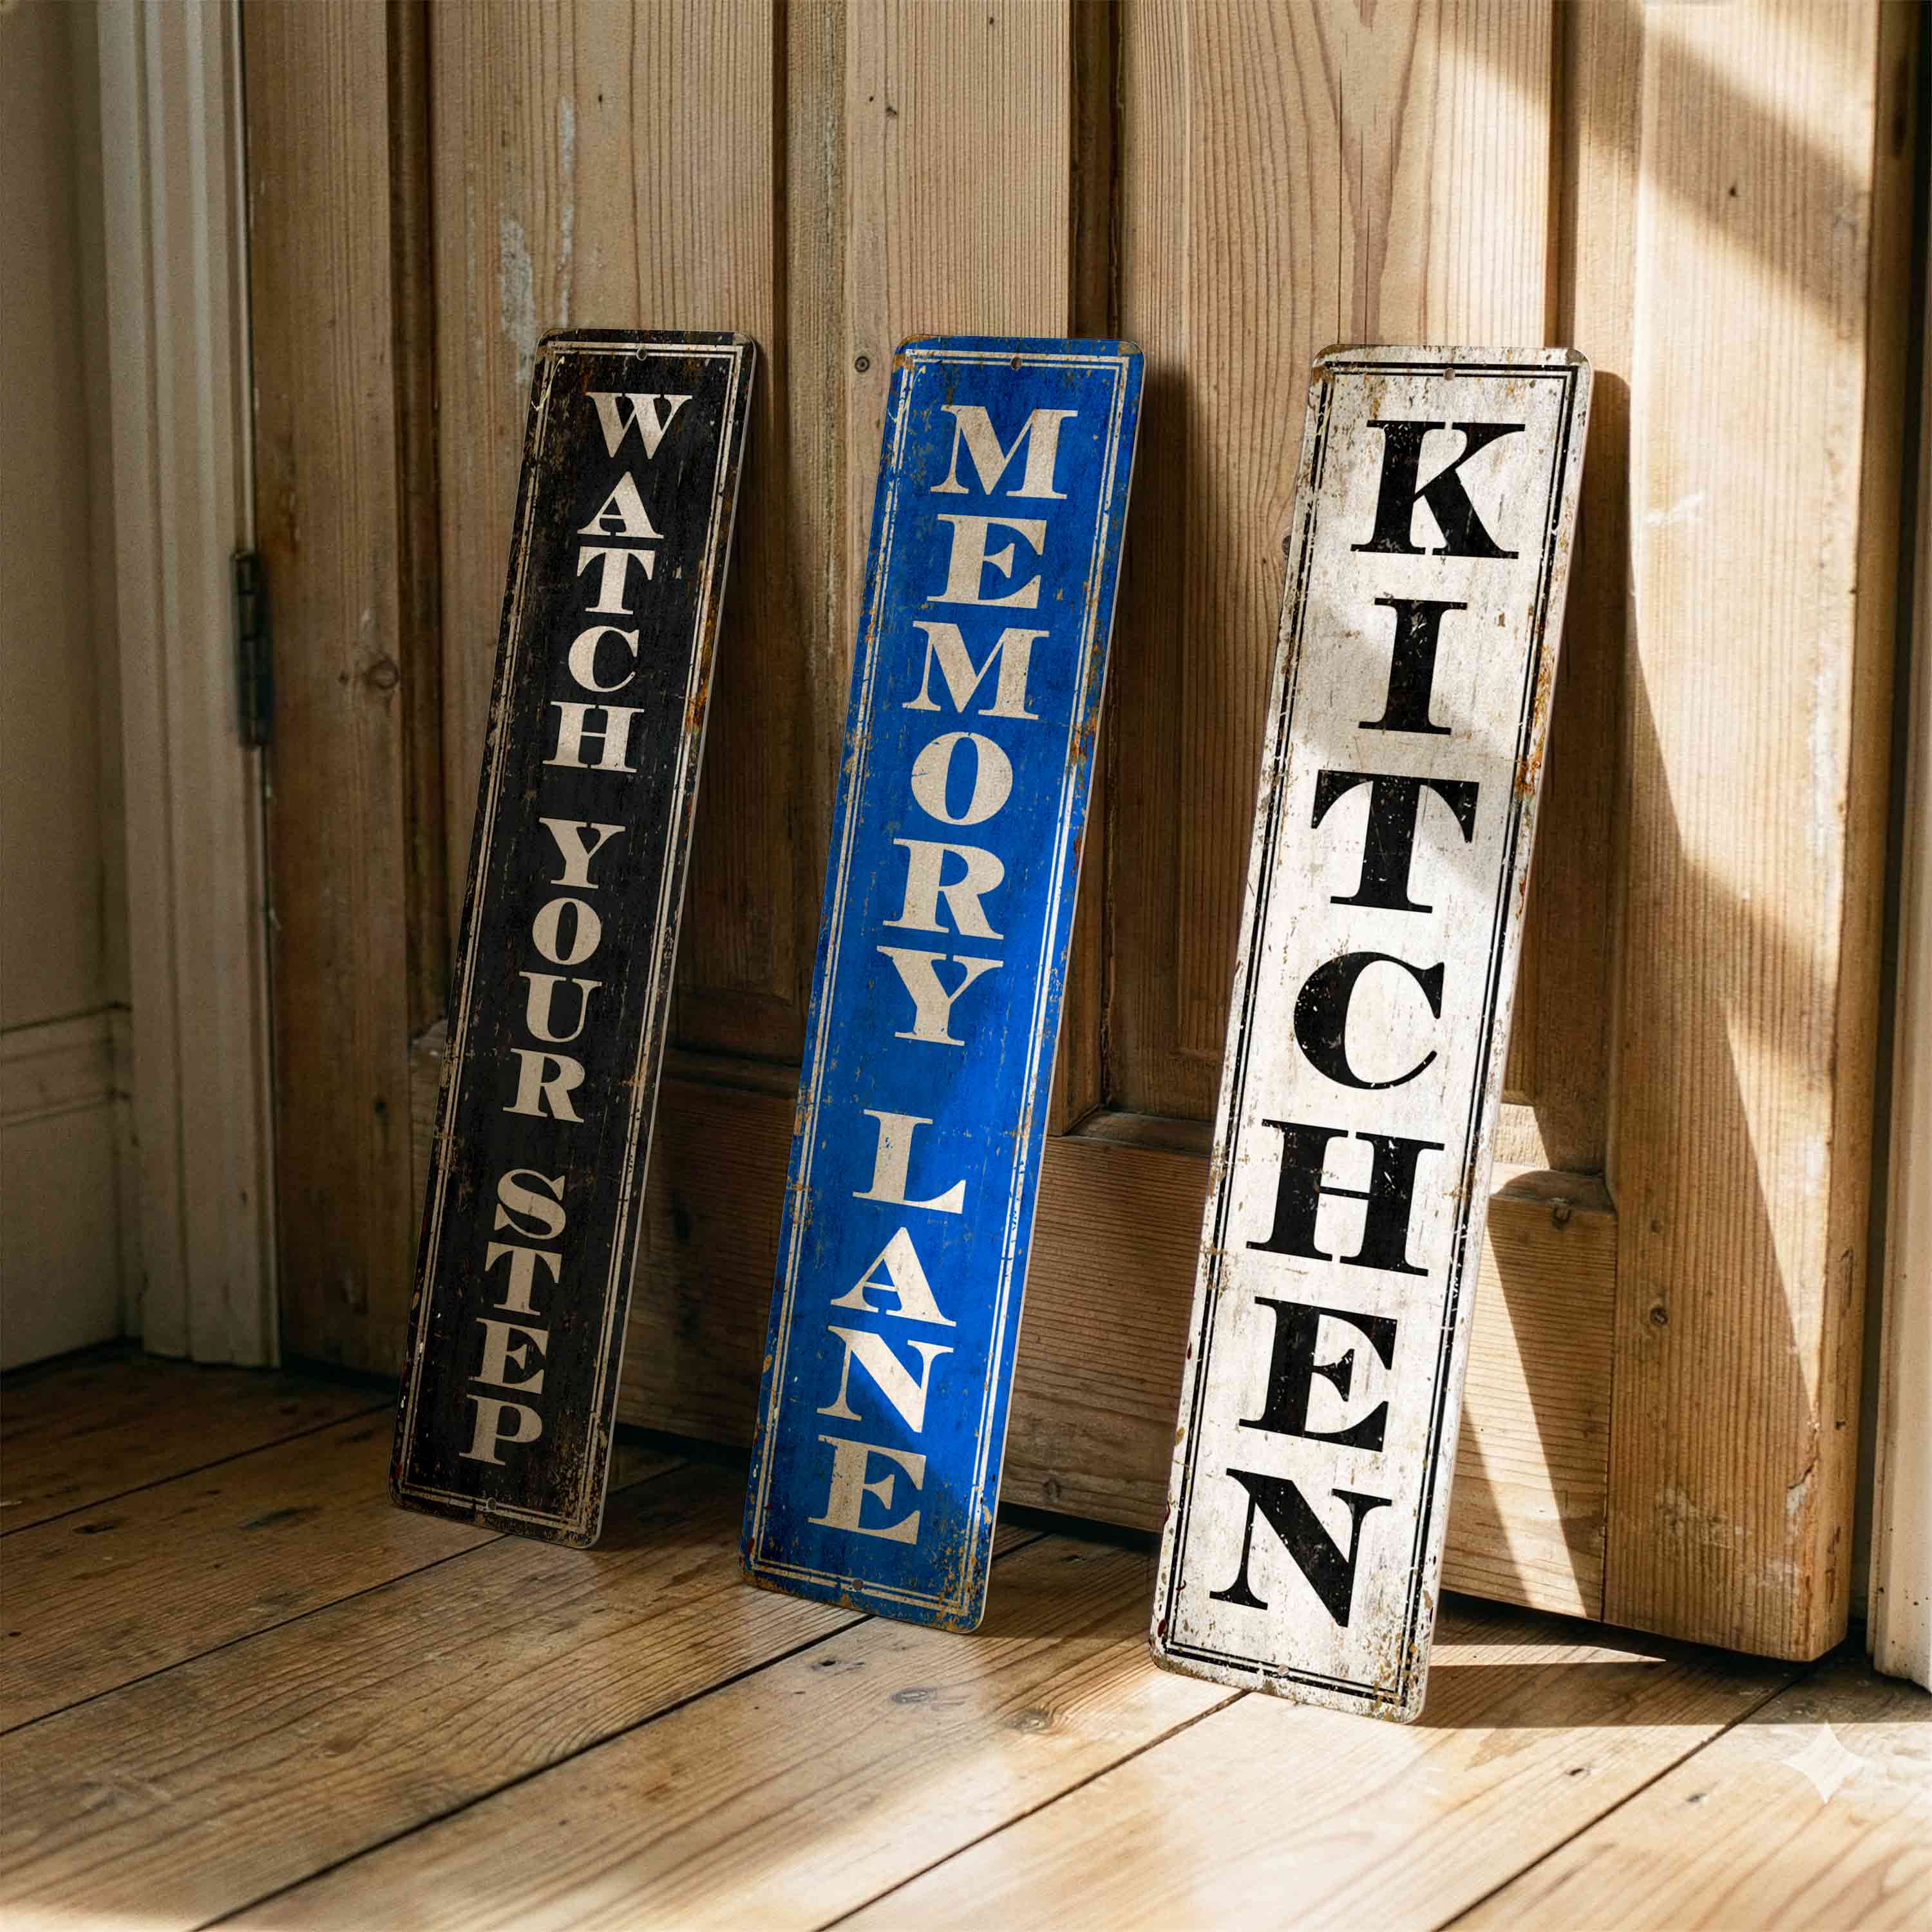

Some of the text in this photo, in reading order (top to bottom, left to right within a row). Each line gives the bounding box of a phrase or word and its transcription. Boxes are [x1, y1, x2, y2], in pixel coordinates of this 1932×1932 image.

[459, 392, 692, 1465] WATCH YOUR STEP
[809, 405, 1078, 1544] MEMORY LANE
[1209, 420, 1525, 1627] KITCHEN
